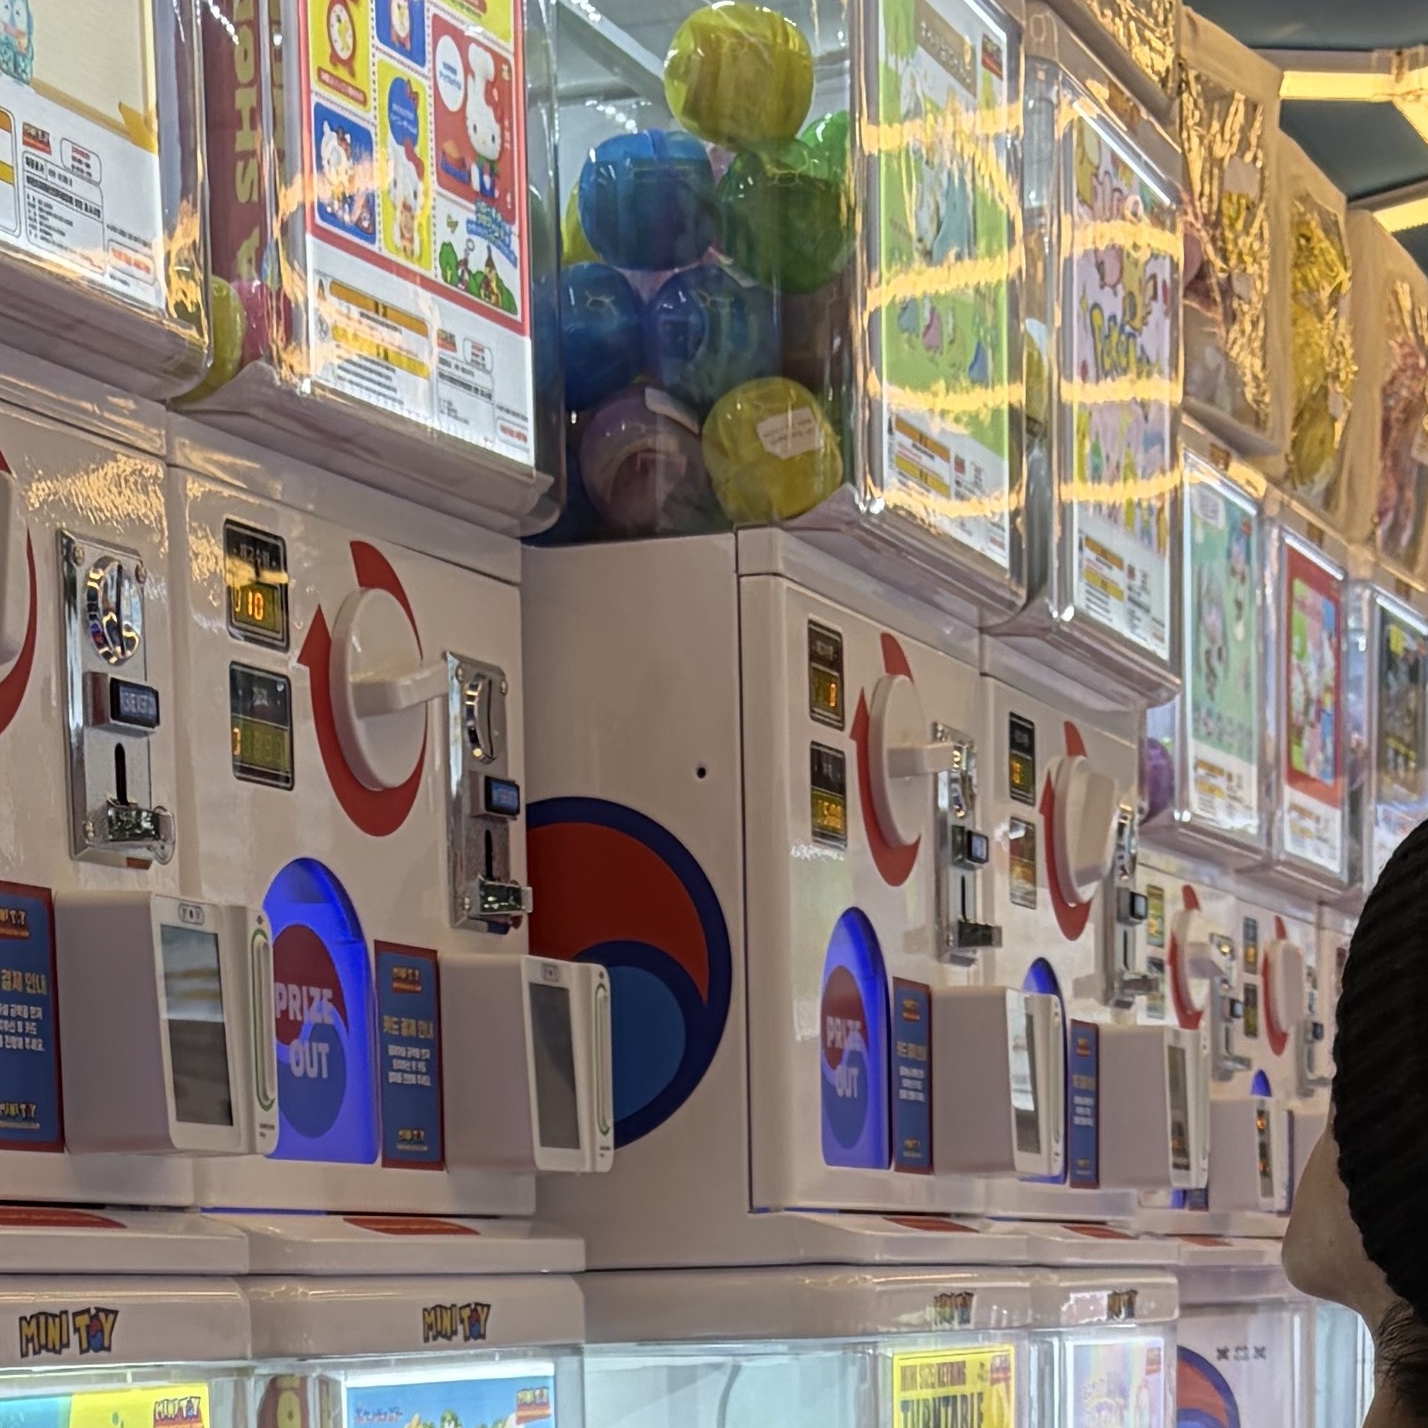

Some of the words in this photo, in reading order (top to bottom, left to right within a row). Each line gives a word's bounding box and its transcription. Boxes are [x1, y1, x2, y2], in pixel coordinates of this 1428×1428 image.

[275, 982, 334, 1024] PRIZE
[288, 1039, 330, 1079] OUT
[18, 1310, 71, 1359] MINI
[71, 1306, 120, 1355] TOY
[422, 1303, 458, 1344] MINI
